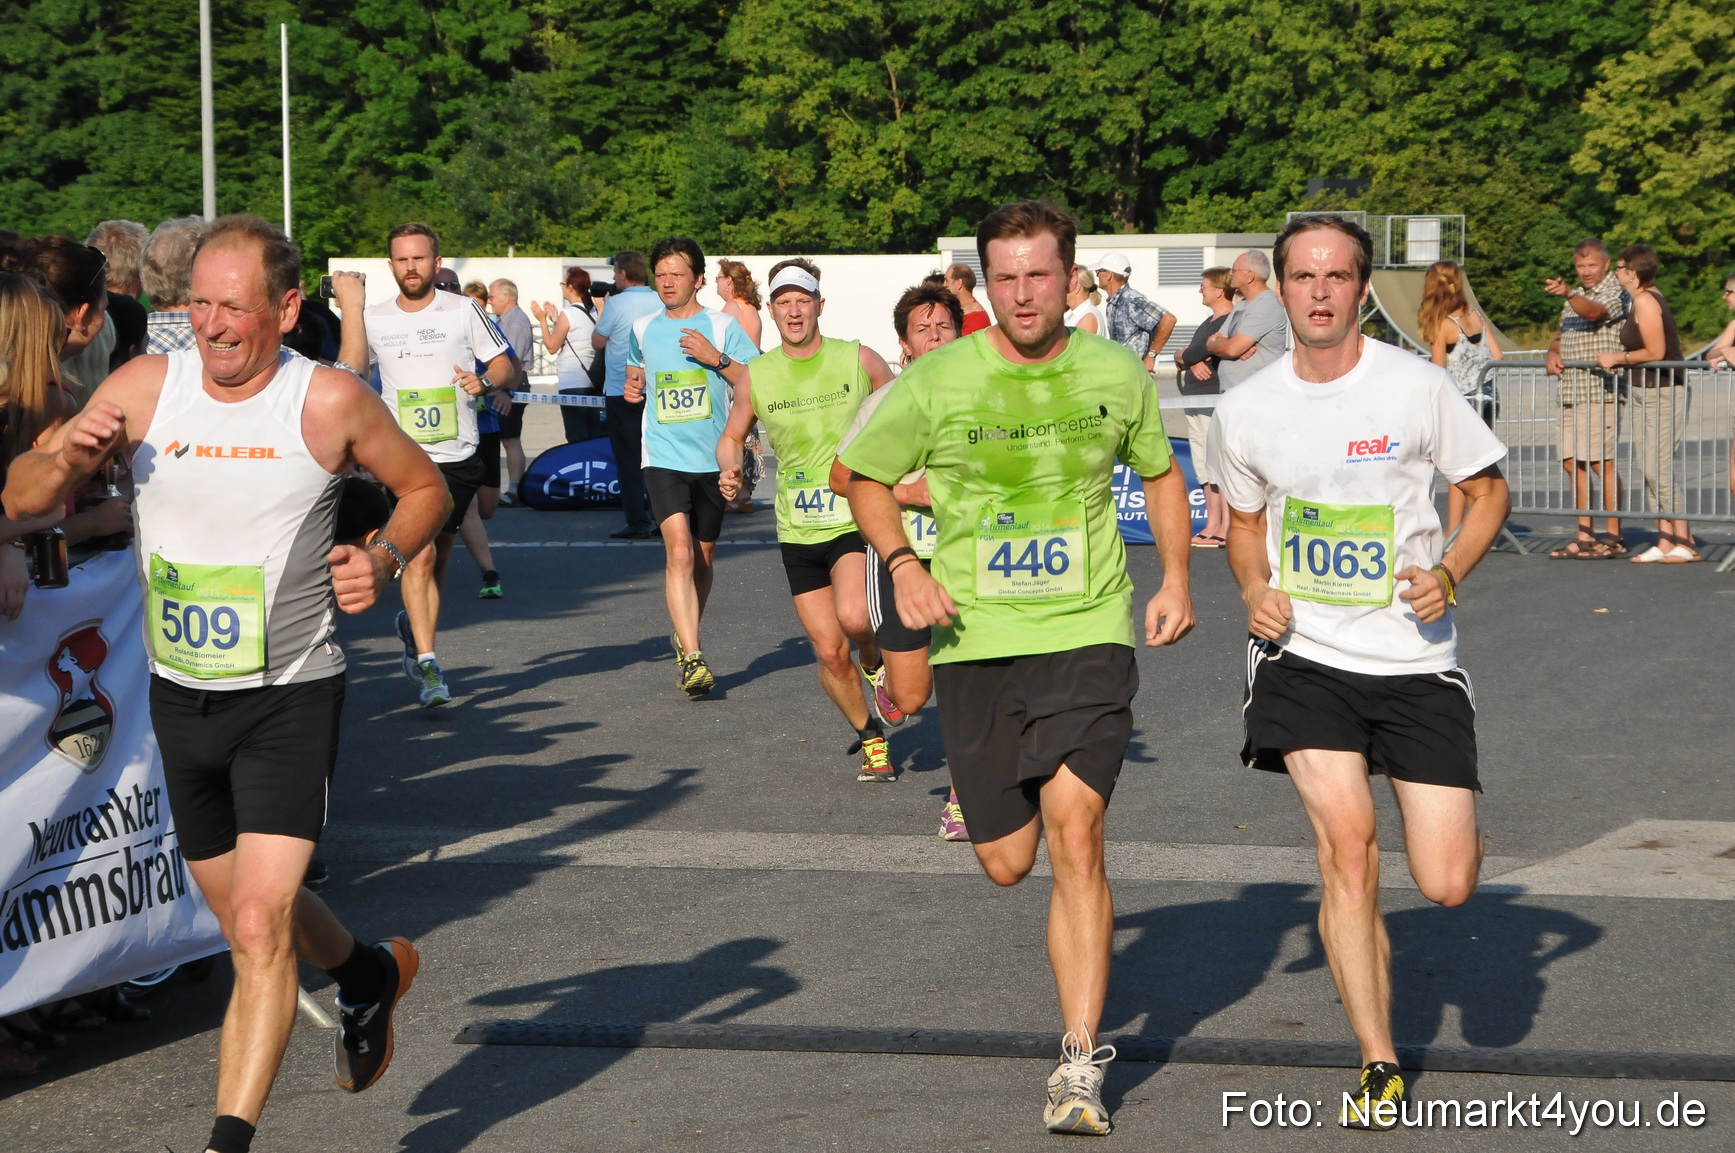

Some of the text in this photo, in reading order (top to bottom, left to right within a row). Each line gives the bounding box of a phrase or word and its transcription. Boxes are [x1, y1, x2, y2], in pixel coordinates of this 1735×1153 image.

[381, 333, 409, 341] PEUGEOT
[419, 333, 446, 341] DESIGN
[658, 386, 707, 410] 1387
[414, 406, 441, 429] 30
[195, 445, 283, 460] KLEBL
[794, 488, 838, 514] 447
[987, 536, 1070, 578] 446
[1285, 534, 1387, 581] 1063
[1033, 579, 1050, 587] Jäger
[1313, 578, 1332, 586] Martin
[1017, 587, 1044, 595] Concepts
[1312, 587, 1352, 596] SB-Warenhaus
[162, 599, 240, 650] 509
[174, 647, 194, 657] Roland
[169, 654, 185, 664] KLEBL
[186, 659, 213, 668] Dynamics
[27, 783, 161, 869] Neumarkter
